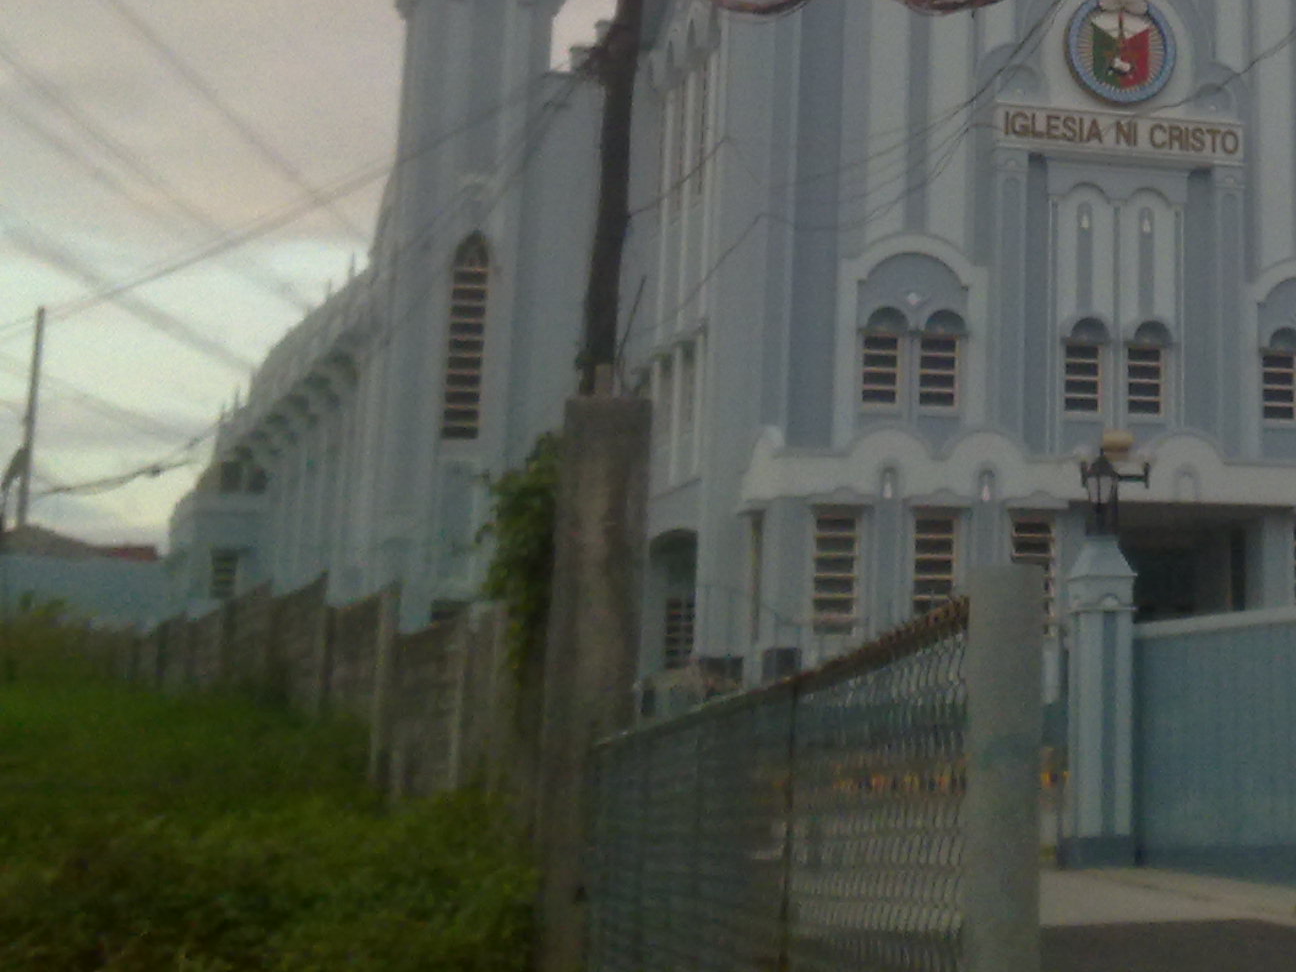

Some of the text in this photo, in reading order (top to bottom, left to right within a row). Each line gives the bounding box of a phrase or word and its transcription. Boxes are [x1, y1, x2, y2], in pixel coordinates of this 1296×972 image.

[1003, 111, 1240, 155] IGLESIA NI CRISTO
